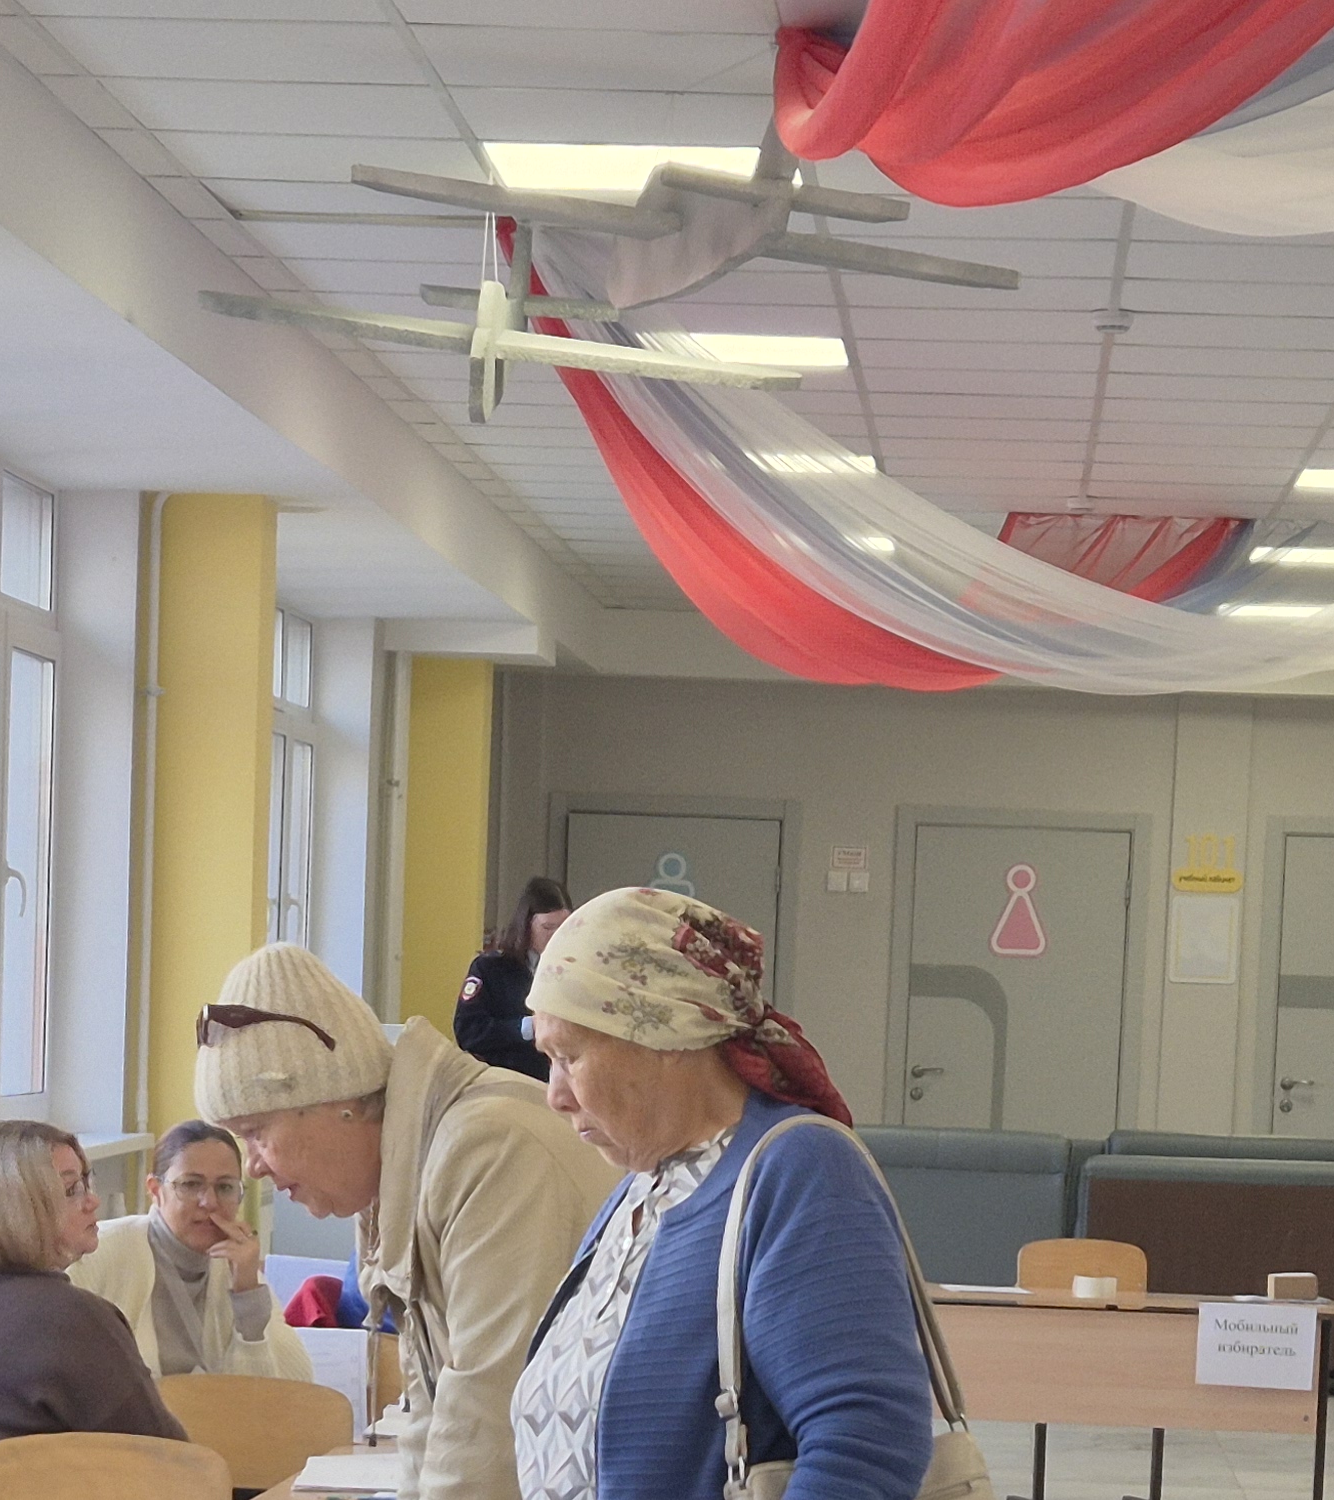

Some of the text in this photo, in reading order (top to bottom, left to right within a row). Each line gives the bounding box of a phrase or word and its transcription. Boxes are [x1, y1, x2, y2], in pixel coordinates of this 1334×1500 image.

[1185, 833, 1235, 867] 101
[1214, 1318, 1299, 1335] Мобильный
[1217, 1340, 1296, 1357] избиратель
